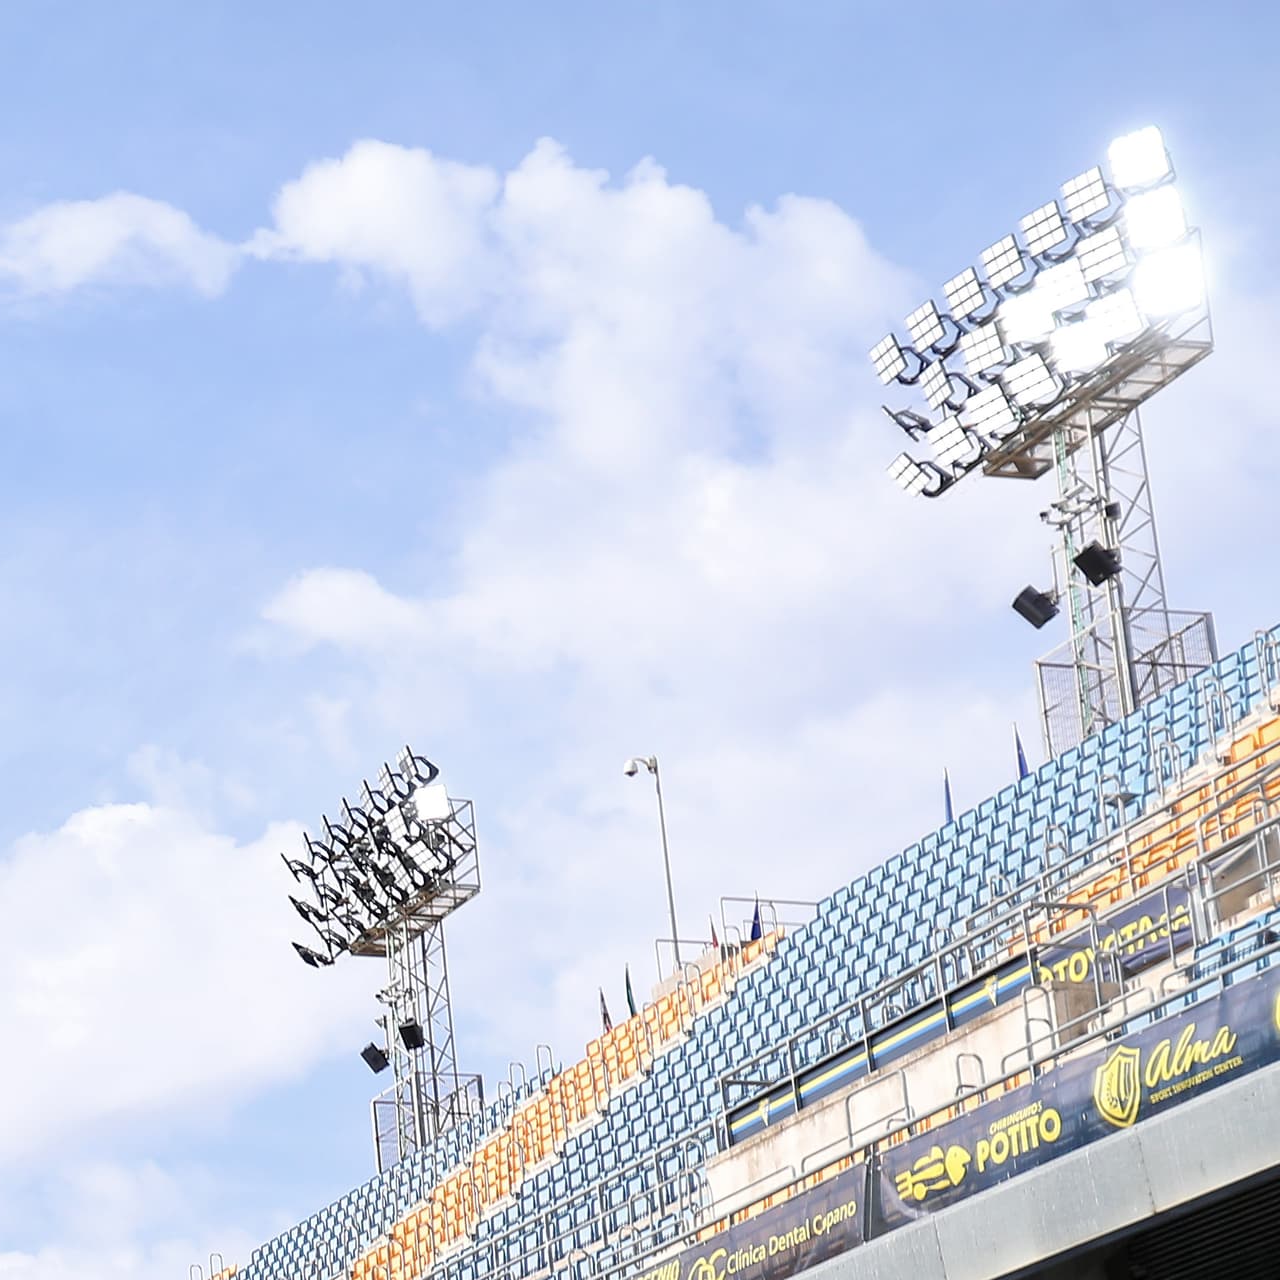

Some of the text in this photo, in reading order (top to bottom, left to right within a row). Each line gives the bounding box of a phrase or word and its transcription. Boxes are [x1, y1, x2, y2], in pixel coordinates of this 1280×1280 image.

[976, 1108, 1061, 1172] POTITO
[726, 1244, 766, 1275] Clínica
[769, 1218, 811, 1254] Dental
